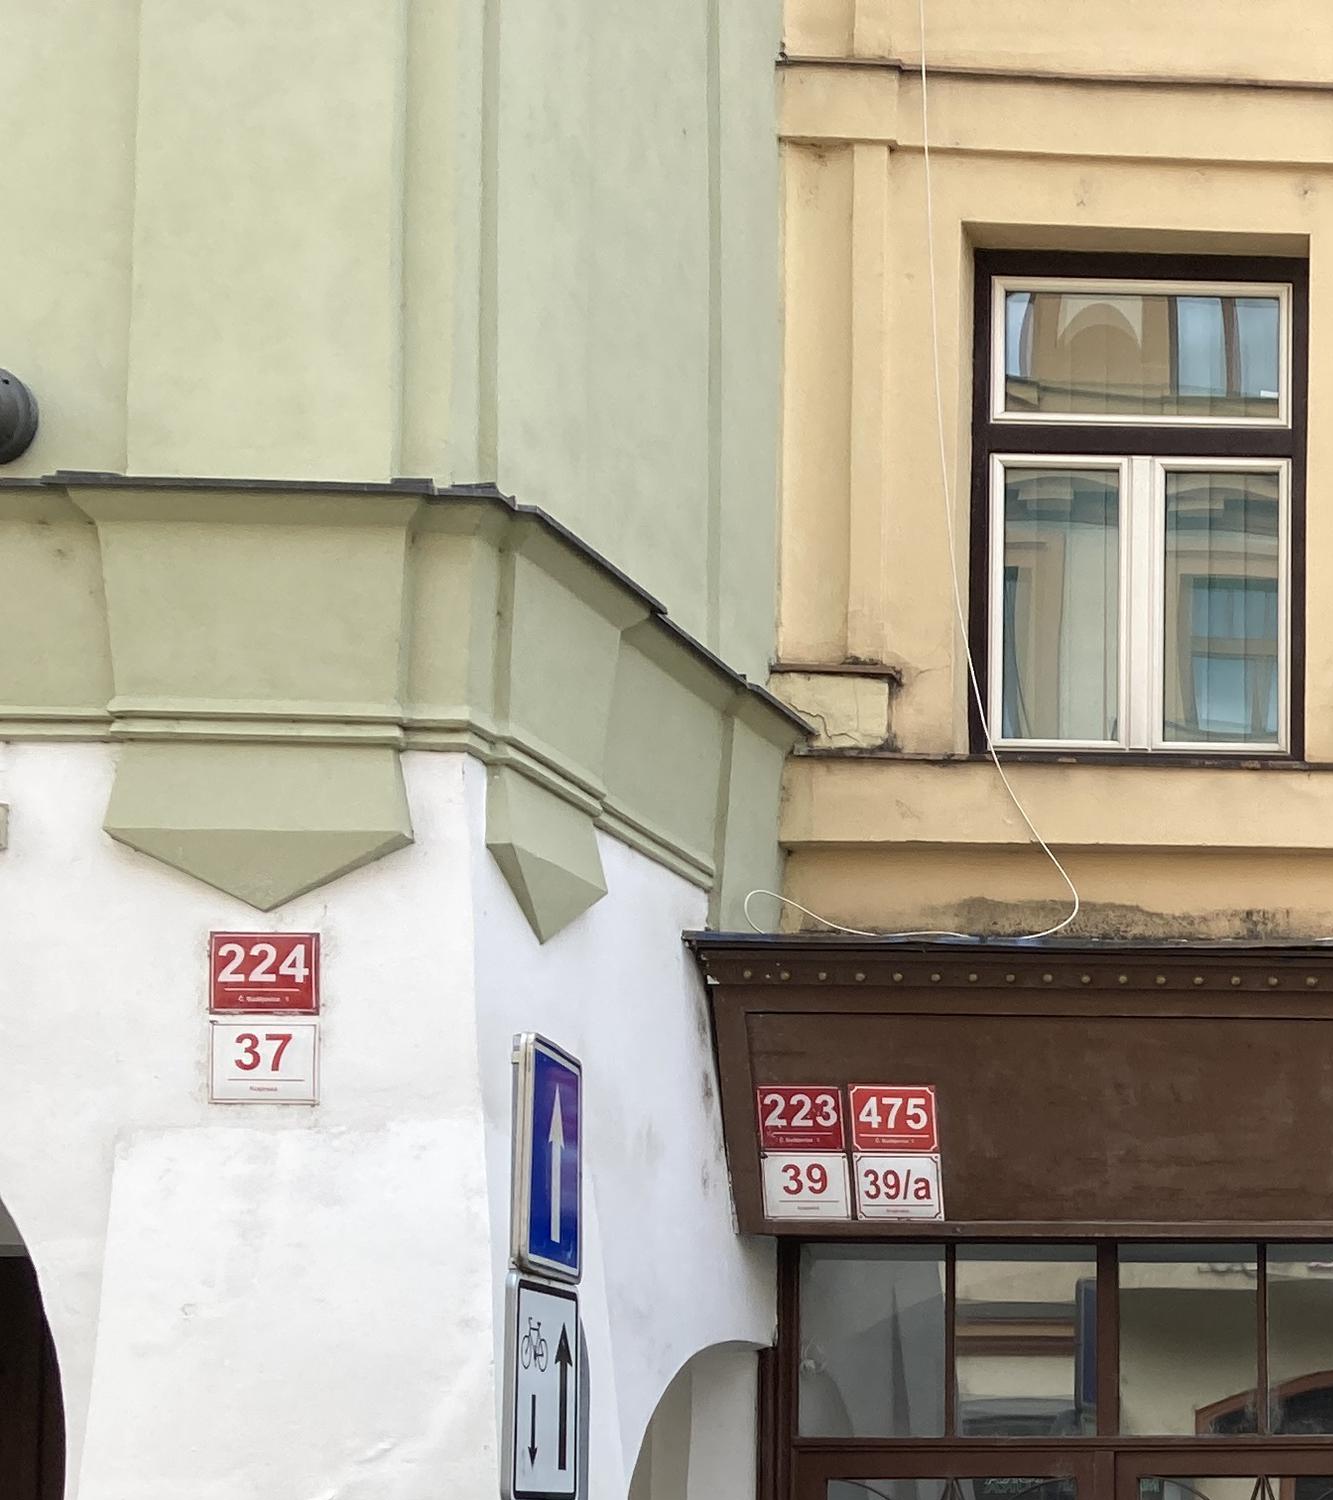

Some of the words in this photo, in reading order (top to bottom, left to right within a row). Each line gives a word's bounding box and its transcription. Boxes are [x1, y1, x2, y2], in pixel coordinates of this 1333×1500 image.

[217, 943, 310, 983] 224
[234, 1033, 293, 1072] 37
[763, 1093, 838, 1128] 223
[859, 1096, 929, 1130] 475
[781, 1163, 829, 1196] 39
[863, 1169, 932, 1201] 39/a
